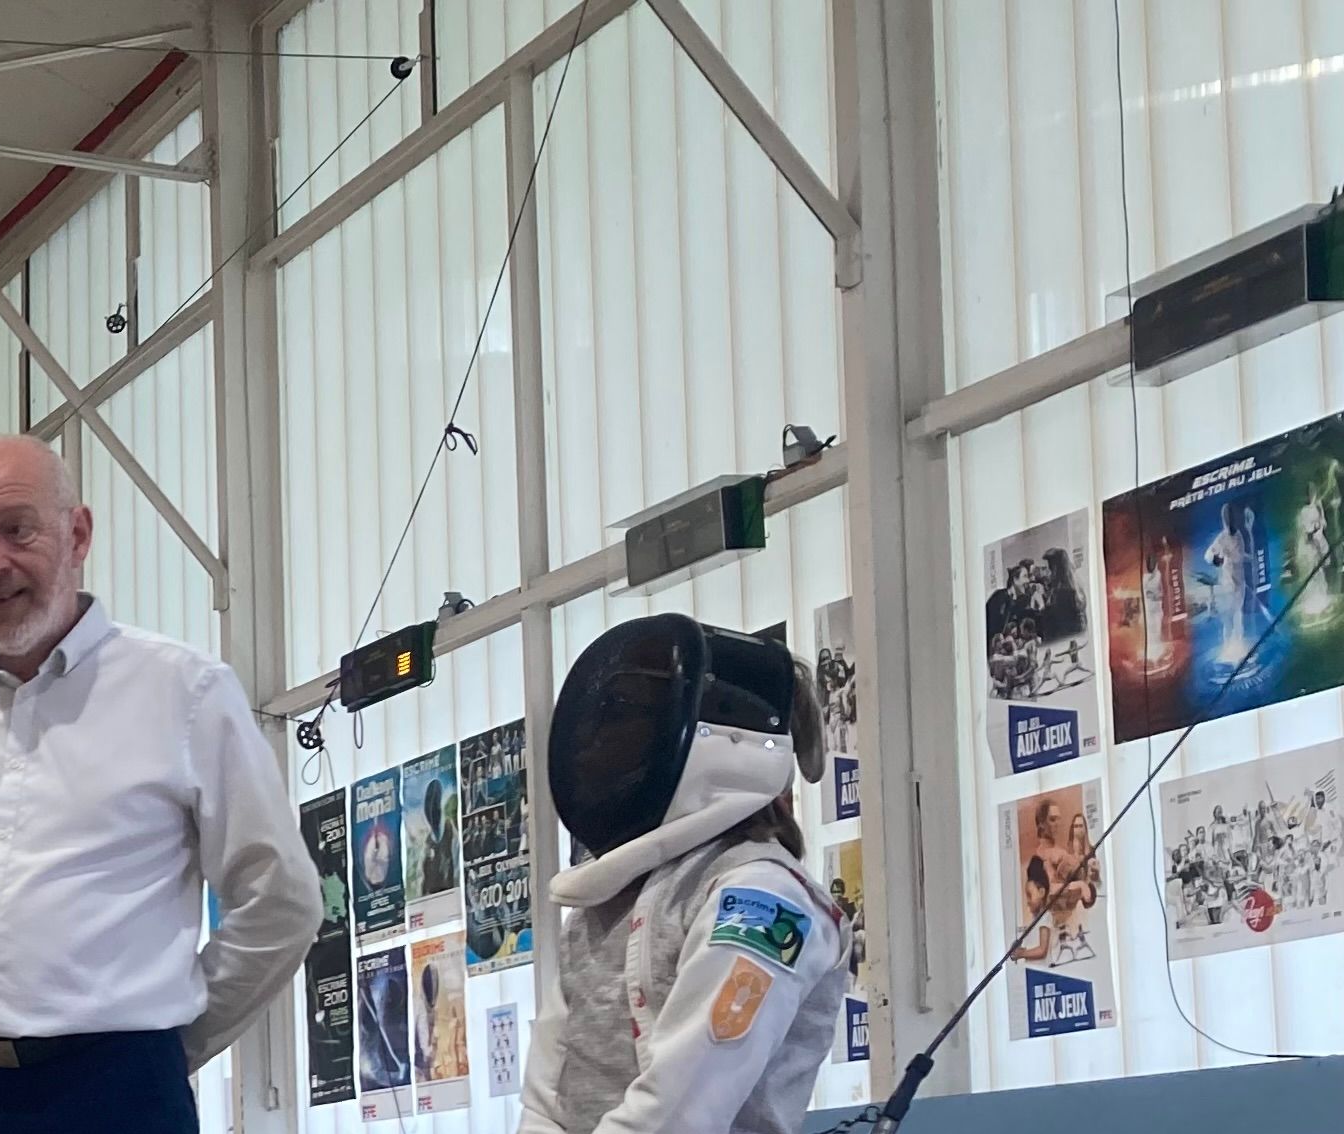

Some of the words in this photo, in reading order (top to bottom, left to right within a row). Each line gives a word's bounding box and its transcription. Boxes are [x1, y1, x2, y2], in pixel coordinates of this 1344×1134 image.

[1227, 474, 1245, 489] AU
[1171, 568, 1181, 612] FLEURET
[1016, 730, 1041, 758] AUX
[1042, 721, 1073, 751] JEUX
[480, 883, 502, 911] RIO
[506, 877, 529, 903] 201
[723, 895, 775, 914] escrime
[324, 989, 348, 1007] 2010
[1034, 997, 1056, 1022] AUX
[1058, 991, 1088, 1019] JEUX
